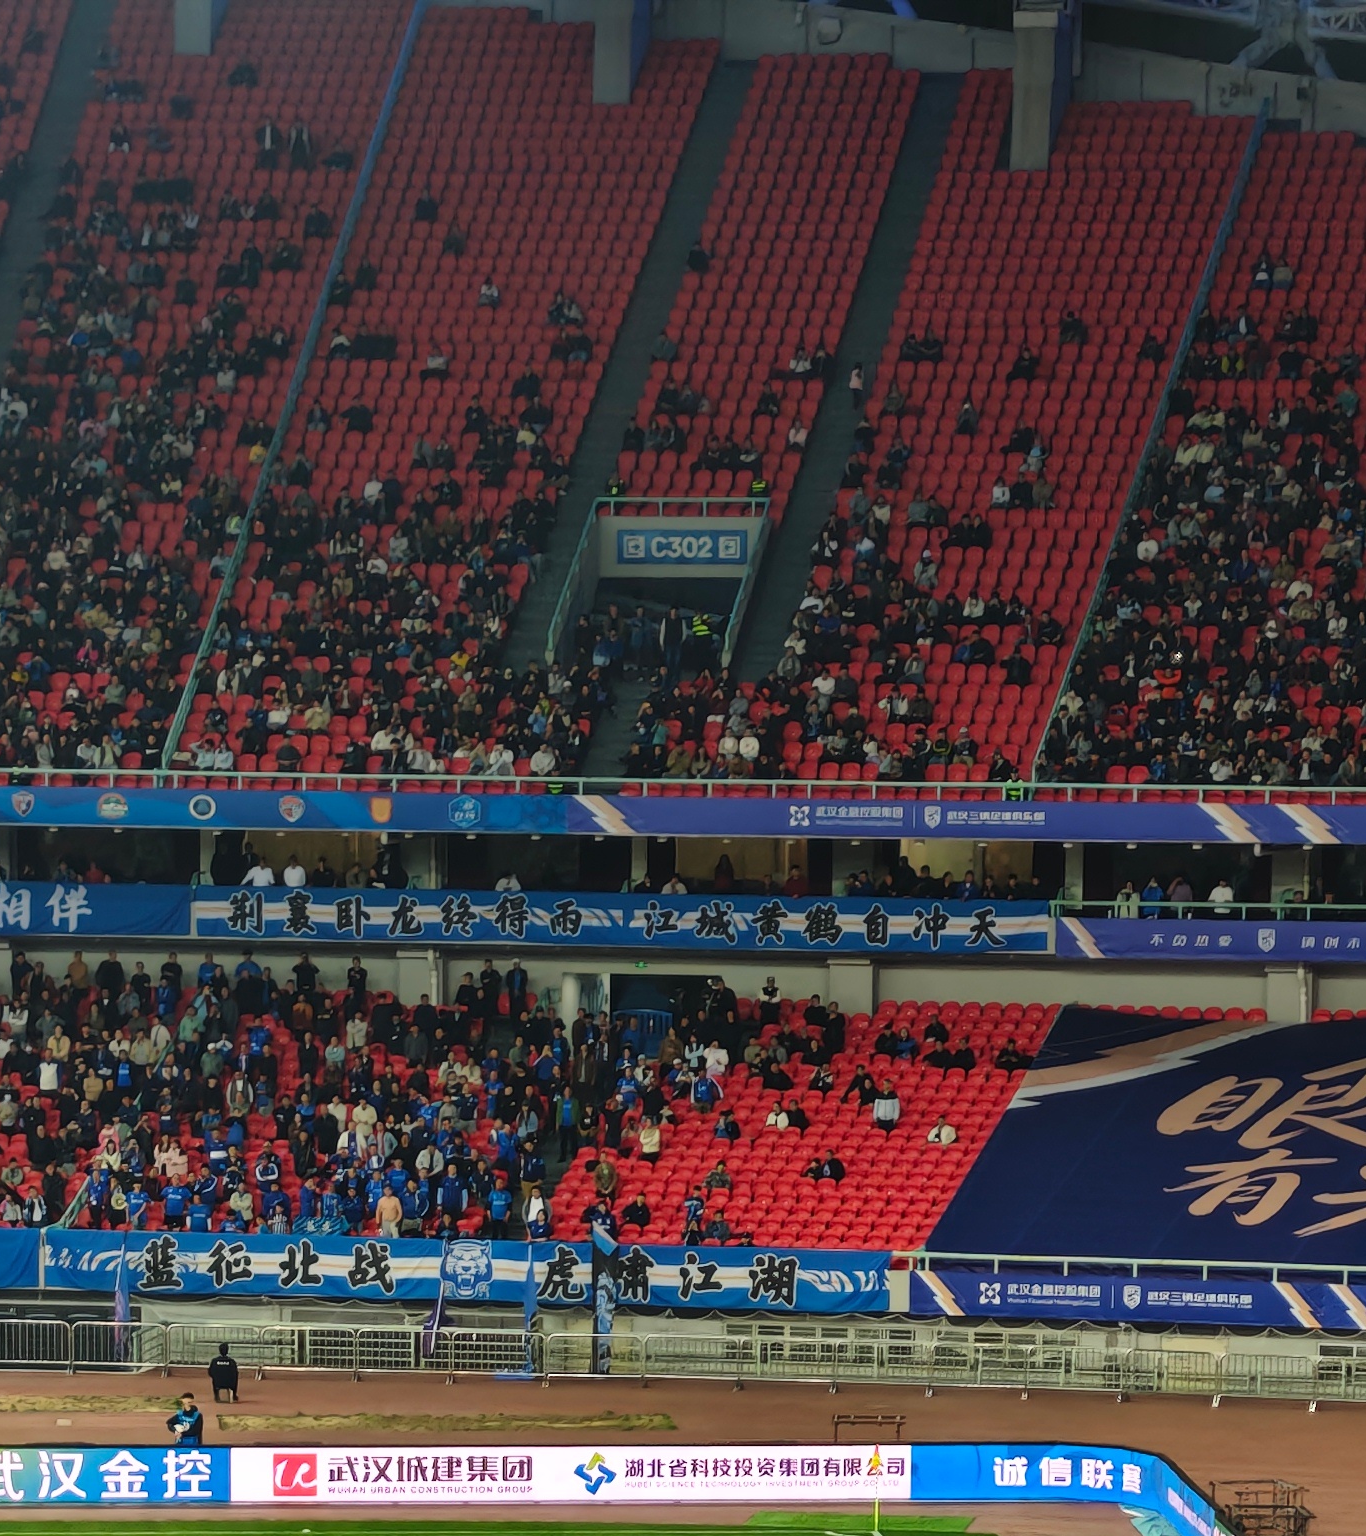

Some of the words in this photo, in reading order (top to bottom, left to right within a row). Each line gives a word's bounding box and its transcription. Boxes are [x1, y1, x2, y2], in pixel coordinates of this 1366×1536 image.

[651, 536, 713, 558] C302
[642, 899, 1006, 949] 江城黄鹤自冲天
[138, 1232, 397, 1297] 蓝征北战
[537, 1243, 800, 1309] 虎啸江湖
[328, 1455, 533, 1483] 武汉城建集团
[624, 1457, 906, 1478] 湖北省科技投资集团有限公司
